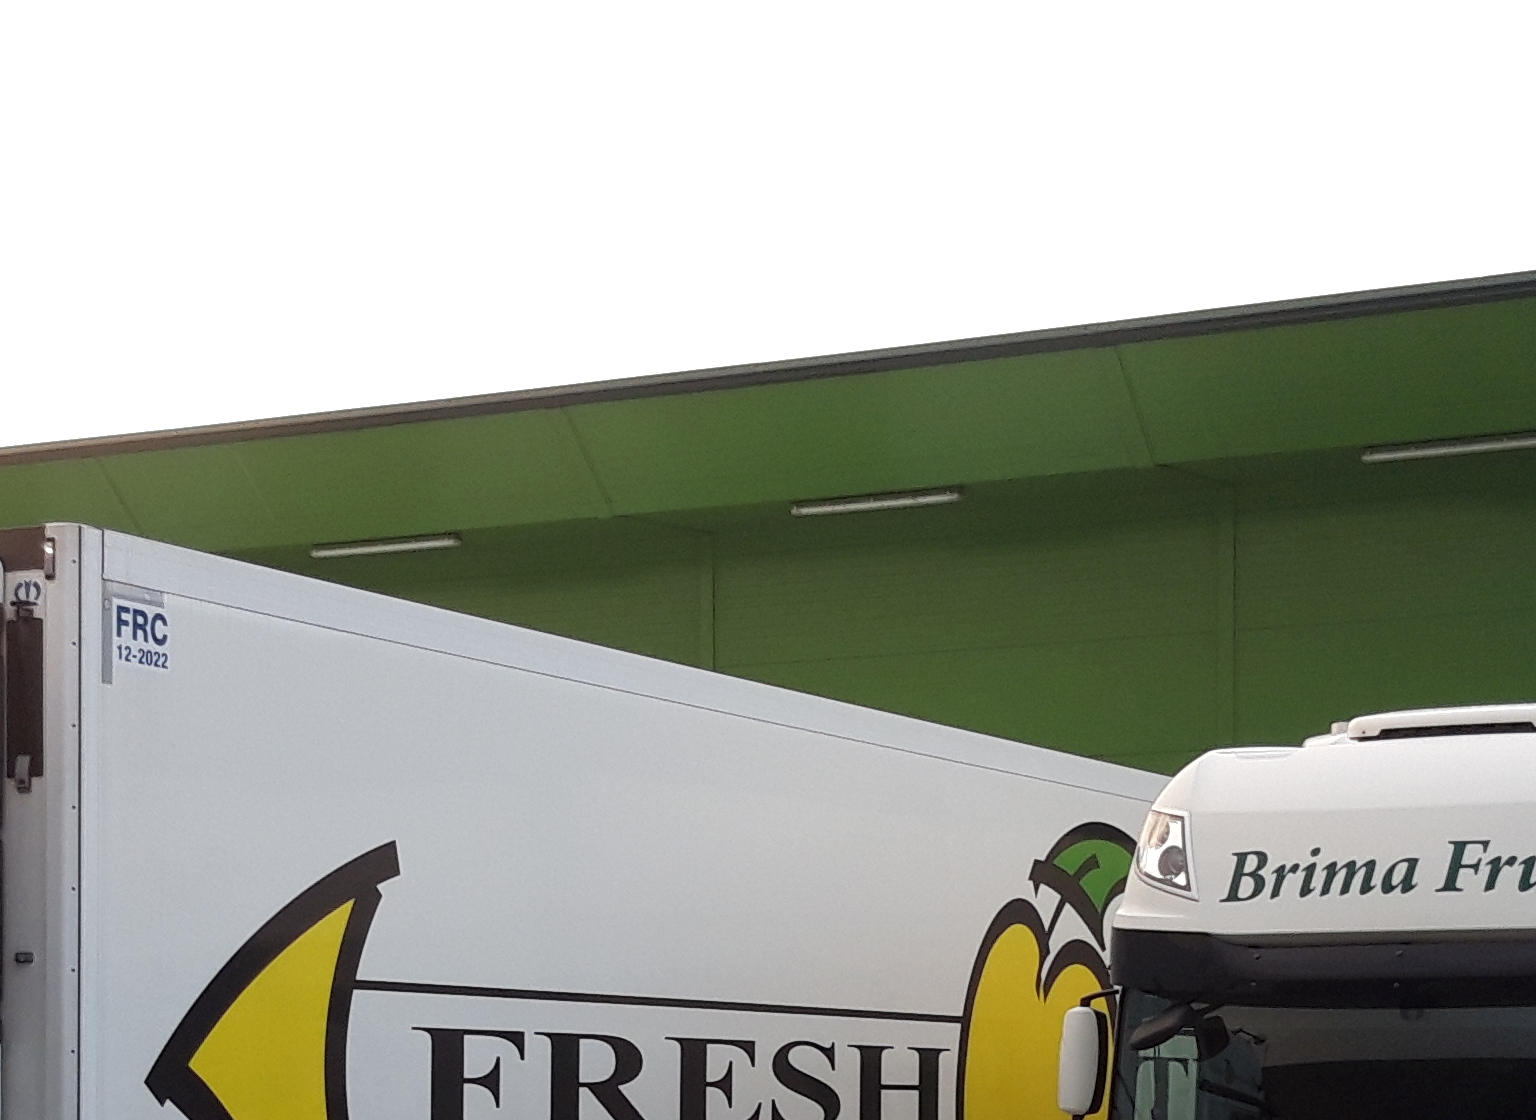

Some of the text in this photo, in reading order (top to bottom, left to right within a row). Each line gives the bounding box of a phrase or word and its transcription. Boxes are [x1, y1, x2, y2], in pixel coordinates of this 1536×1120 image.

[116, 605, 168, 647] FRC
[116, 644, 169, 670] 12-2022
[1219, 846, 1421, 903] Brima
